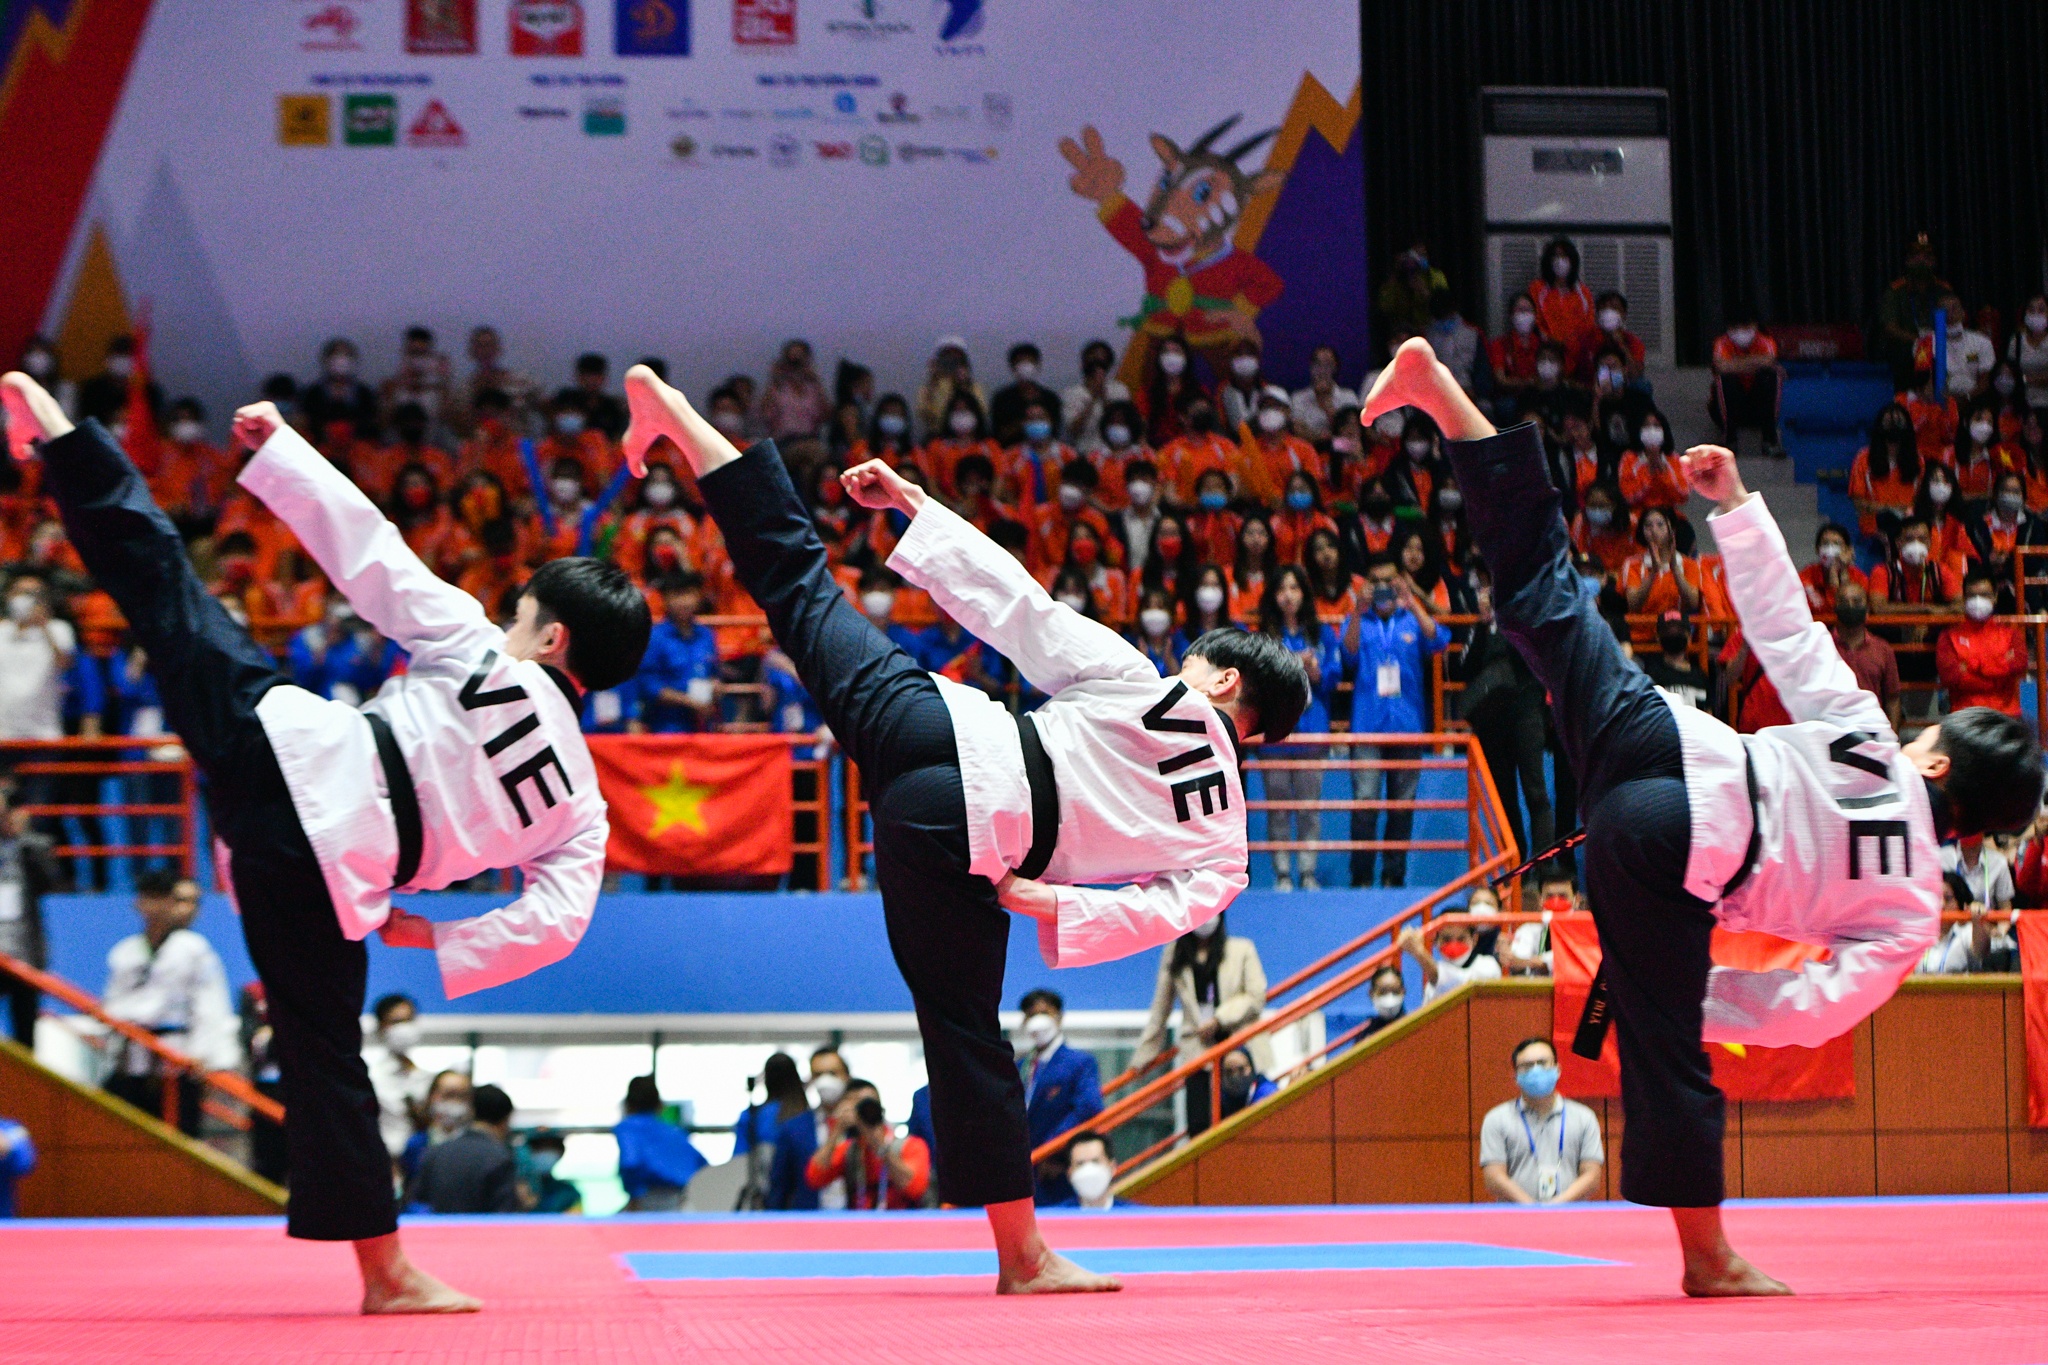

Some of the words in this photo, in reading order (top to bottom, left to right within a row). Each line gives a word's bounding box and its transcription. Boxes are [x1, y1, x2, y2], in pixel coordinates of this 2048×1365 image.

[458, 649, 574, 829] VIE
[1141, 680, 1229, 823] VIE
[1829, 731, 1912, 879] VIE
